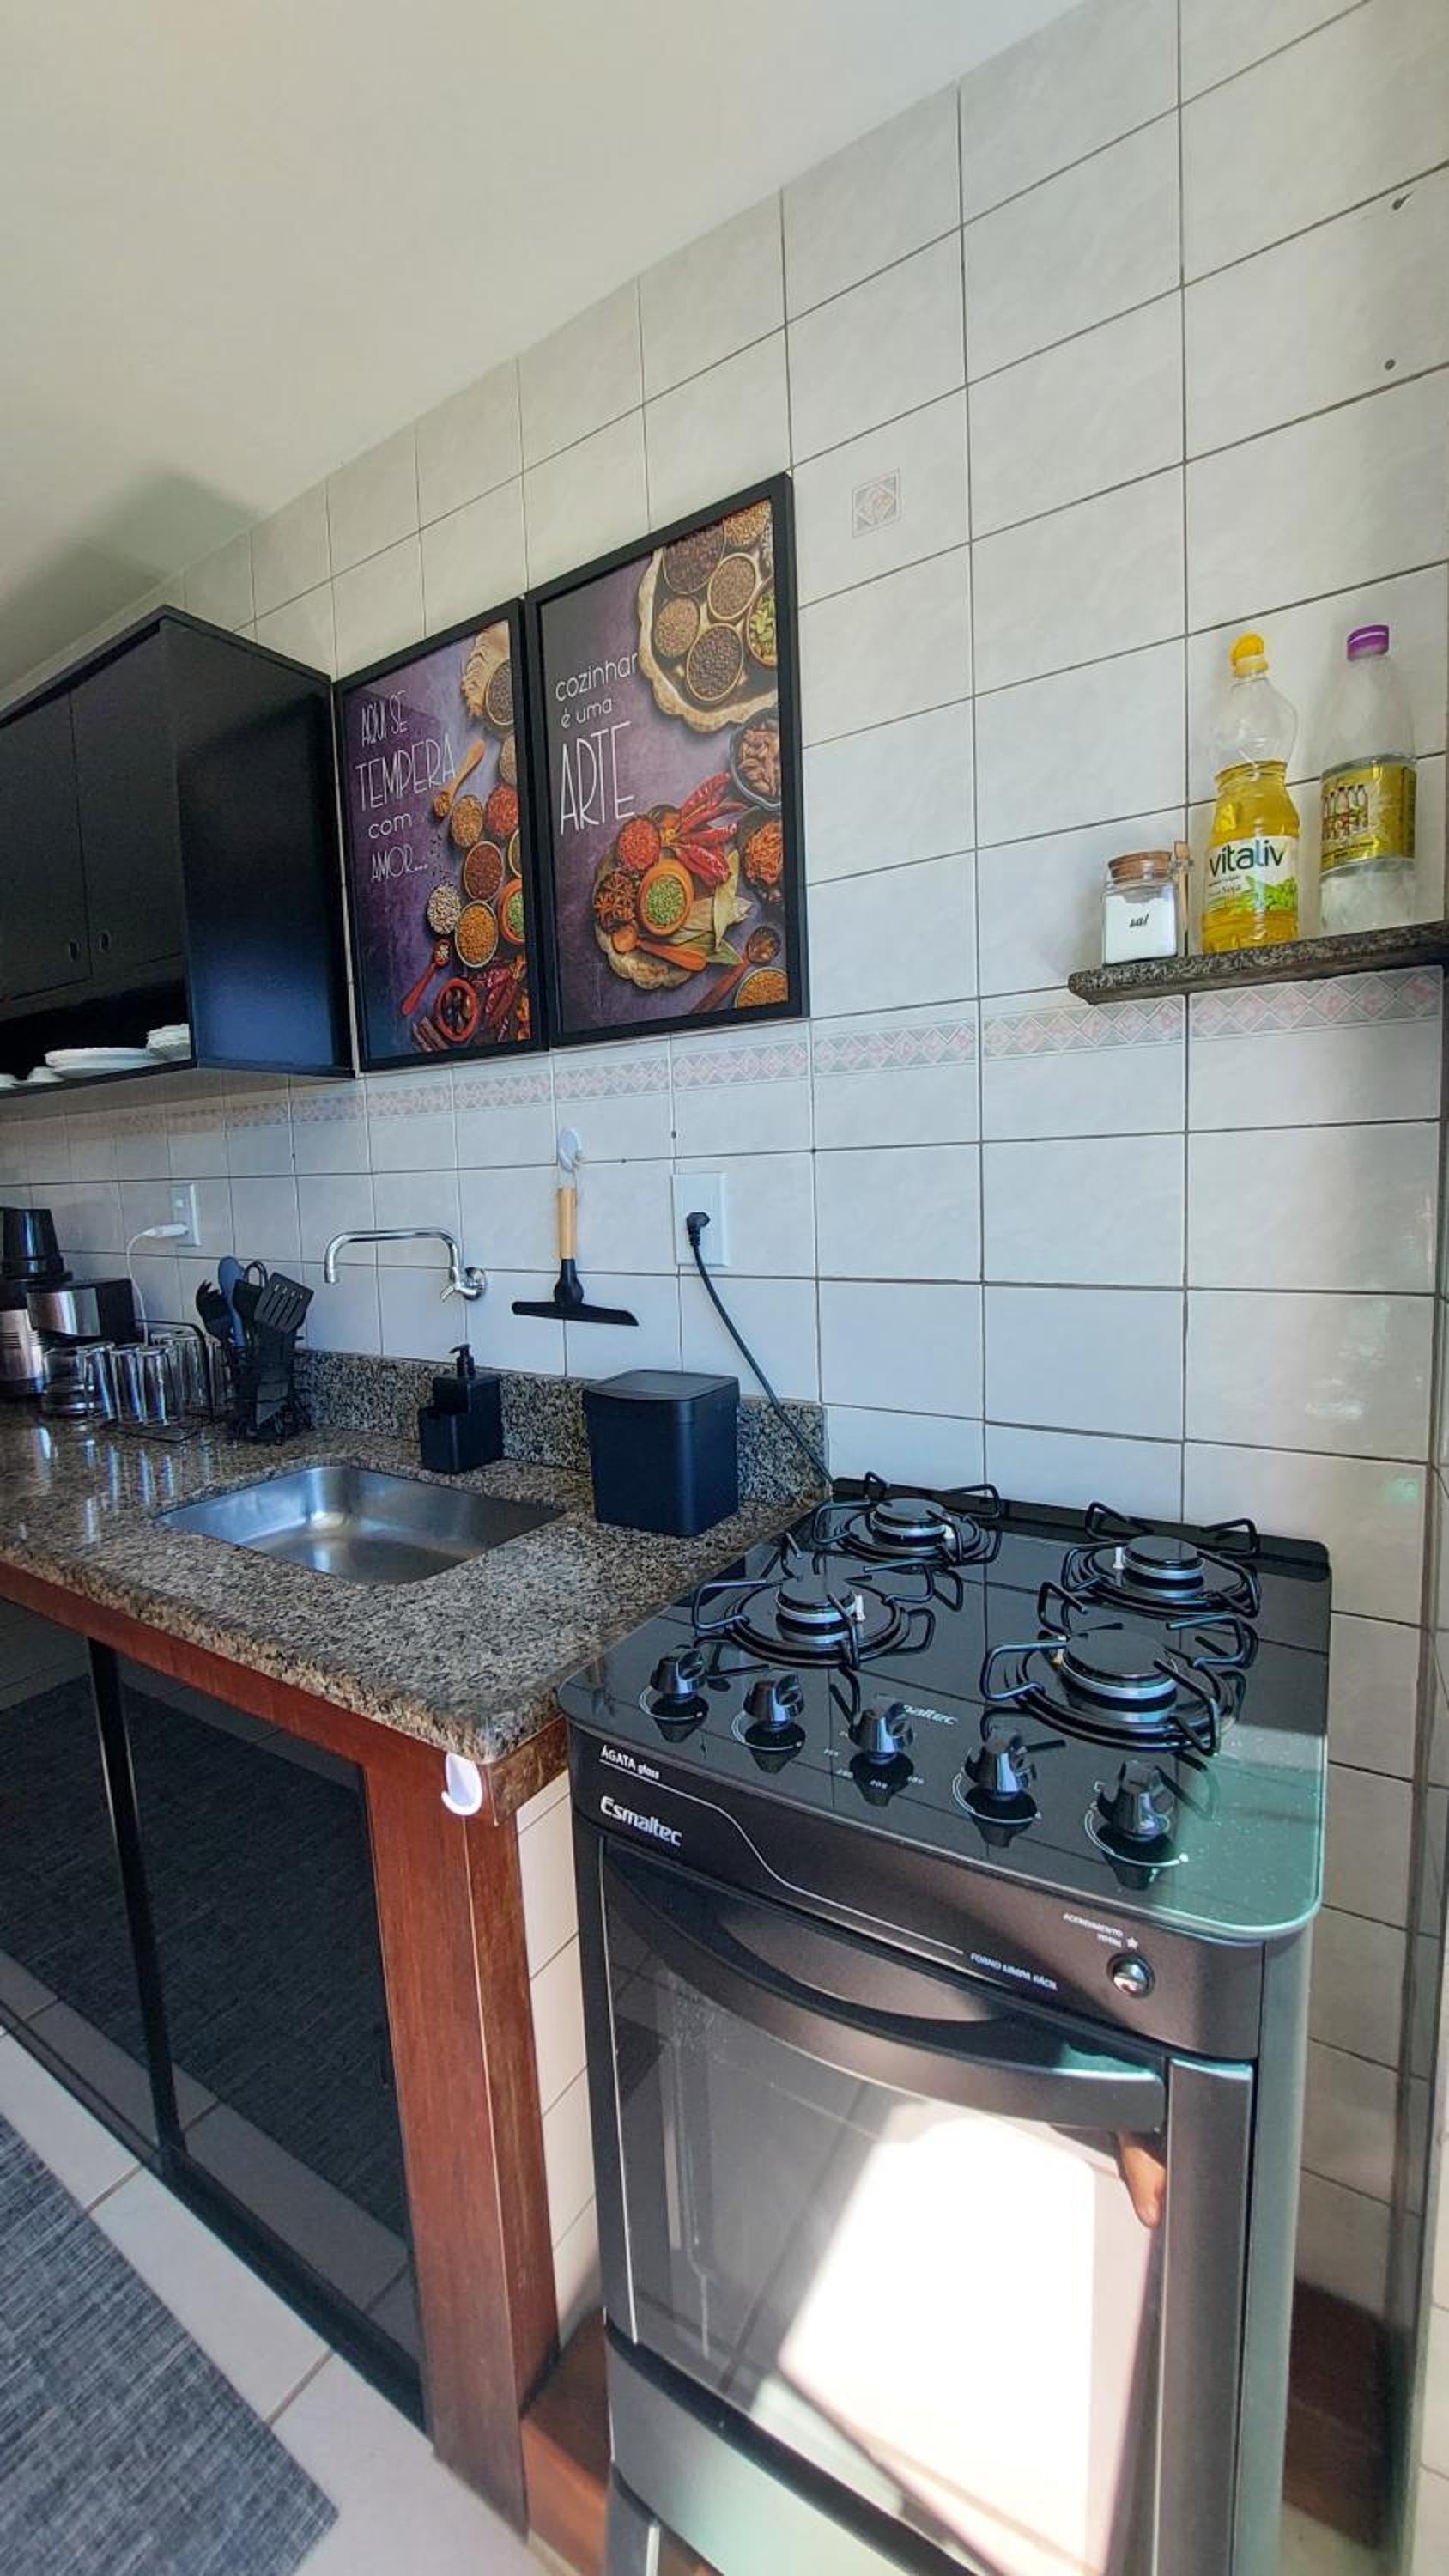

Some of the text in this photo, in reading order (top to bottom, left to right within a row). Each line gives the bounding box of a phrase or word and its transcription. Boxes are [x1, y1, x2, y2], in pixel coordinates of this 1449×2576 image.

[555, 652, 638, 702] cozinhar
[361, 690, 408, 748] AQUI SE
[561, 698, 613, 729] é uma
[355, 732, 457, 811] TEMPERA
[561, 720, 635, 836] ARTE
[368, 813, 413, 839] com
[1210, 840, 1286, 877] vitaliv
[1129, 913, 1149, 928] sal
[601, 1795, 682, 1847] Esmaltec
[970, 1952, 1002, 1971] FORNO
